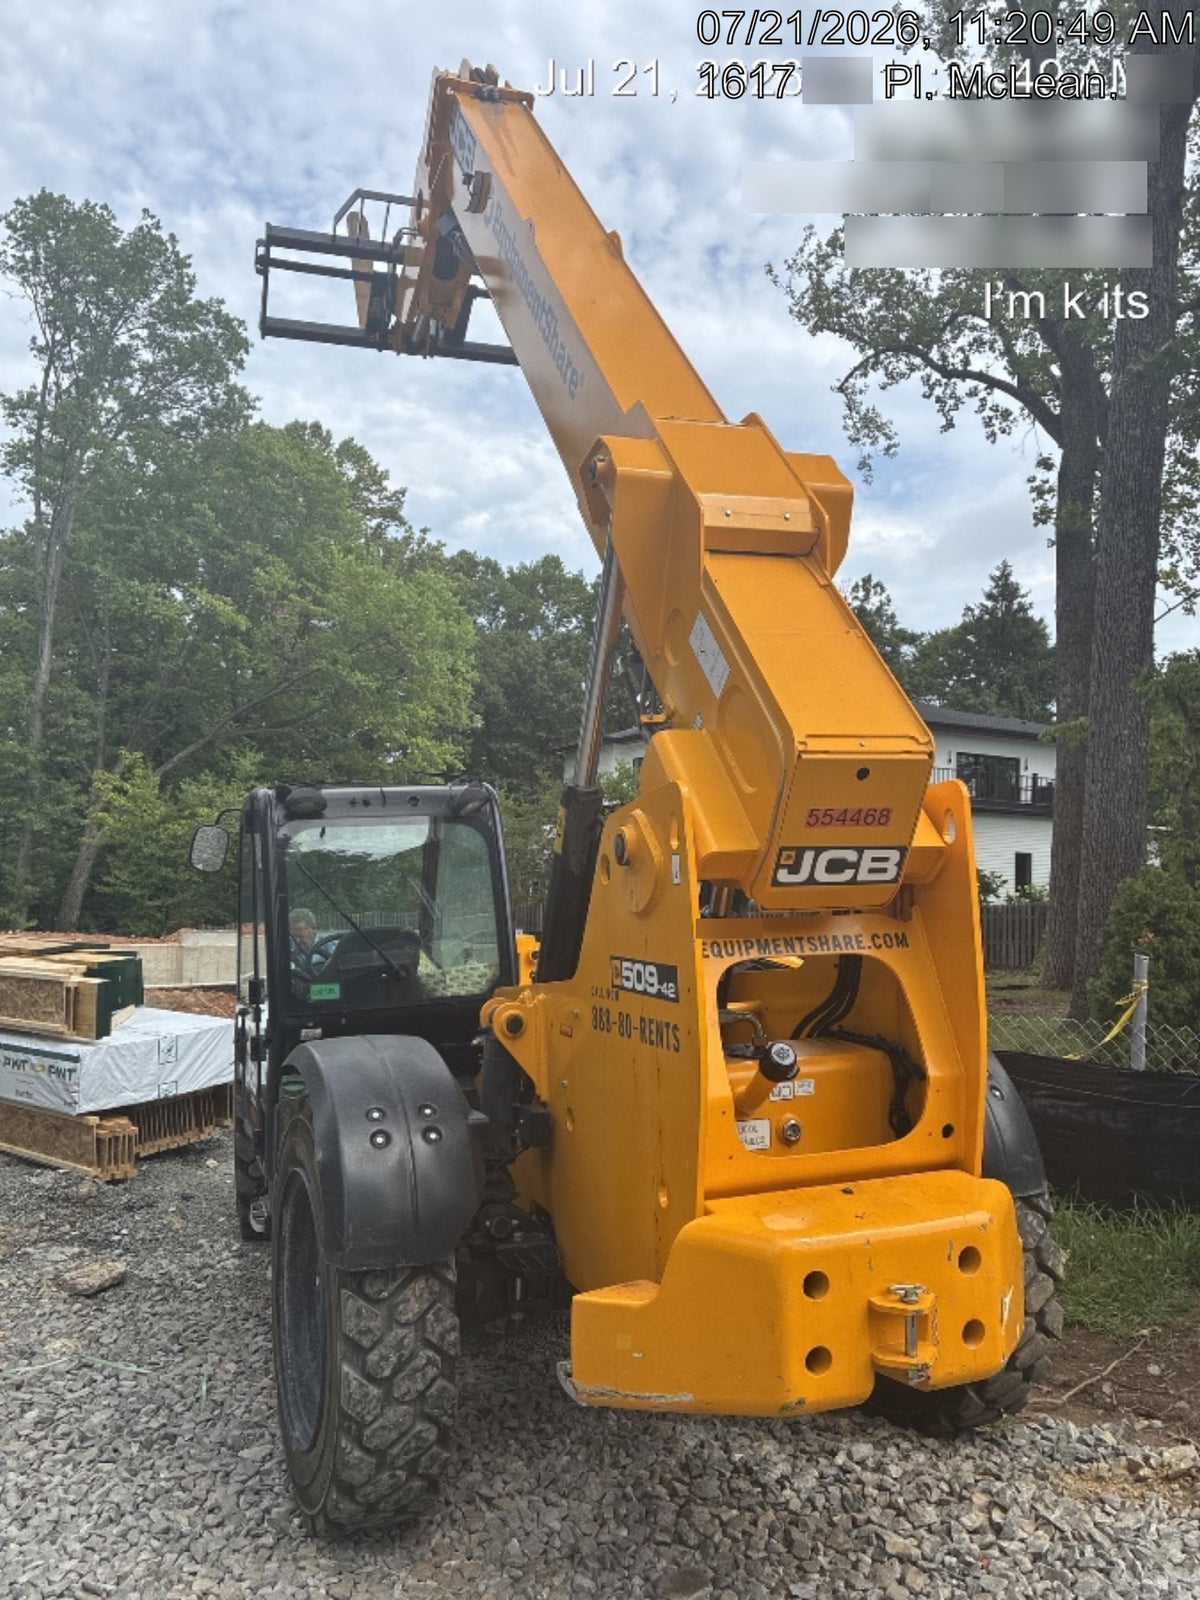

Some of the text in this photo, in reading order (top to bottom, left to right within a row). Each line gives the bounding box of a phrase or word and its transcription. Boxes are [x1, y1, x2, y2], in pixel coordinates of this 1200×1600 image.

[805, 807, 893, 828] 554468
[776, 848, 901, 883] JCB
[701, 932, 910, 959] EQUIPMENTSHARE.COM
[621, 960, 677, 999] 509-42
